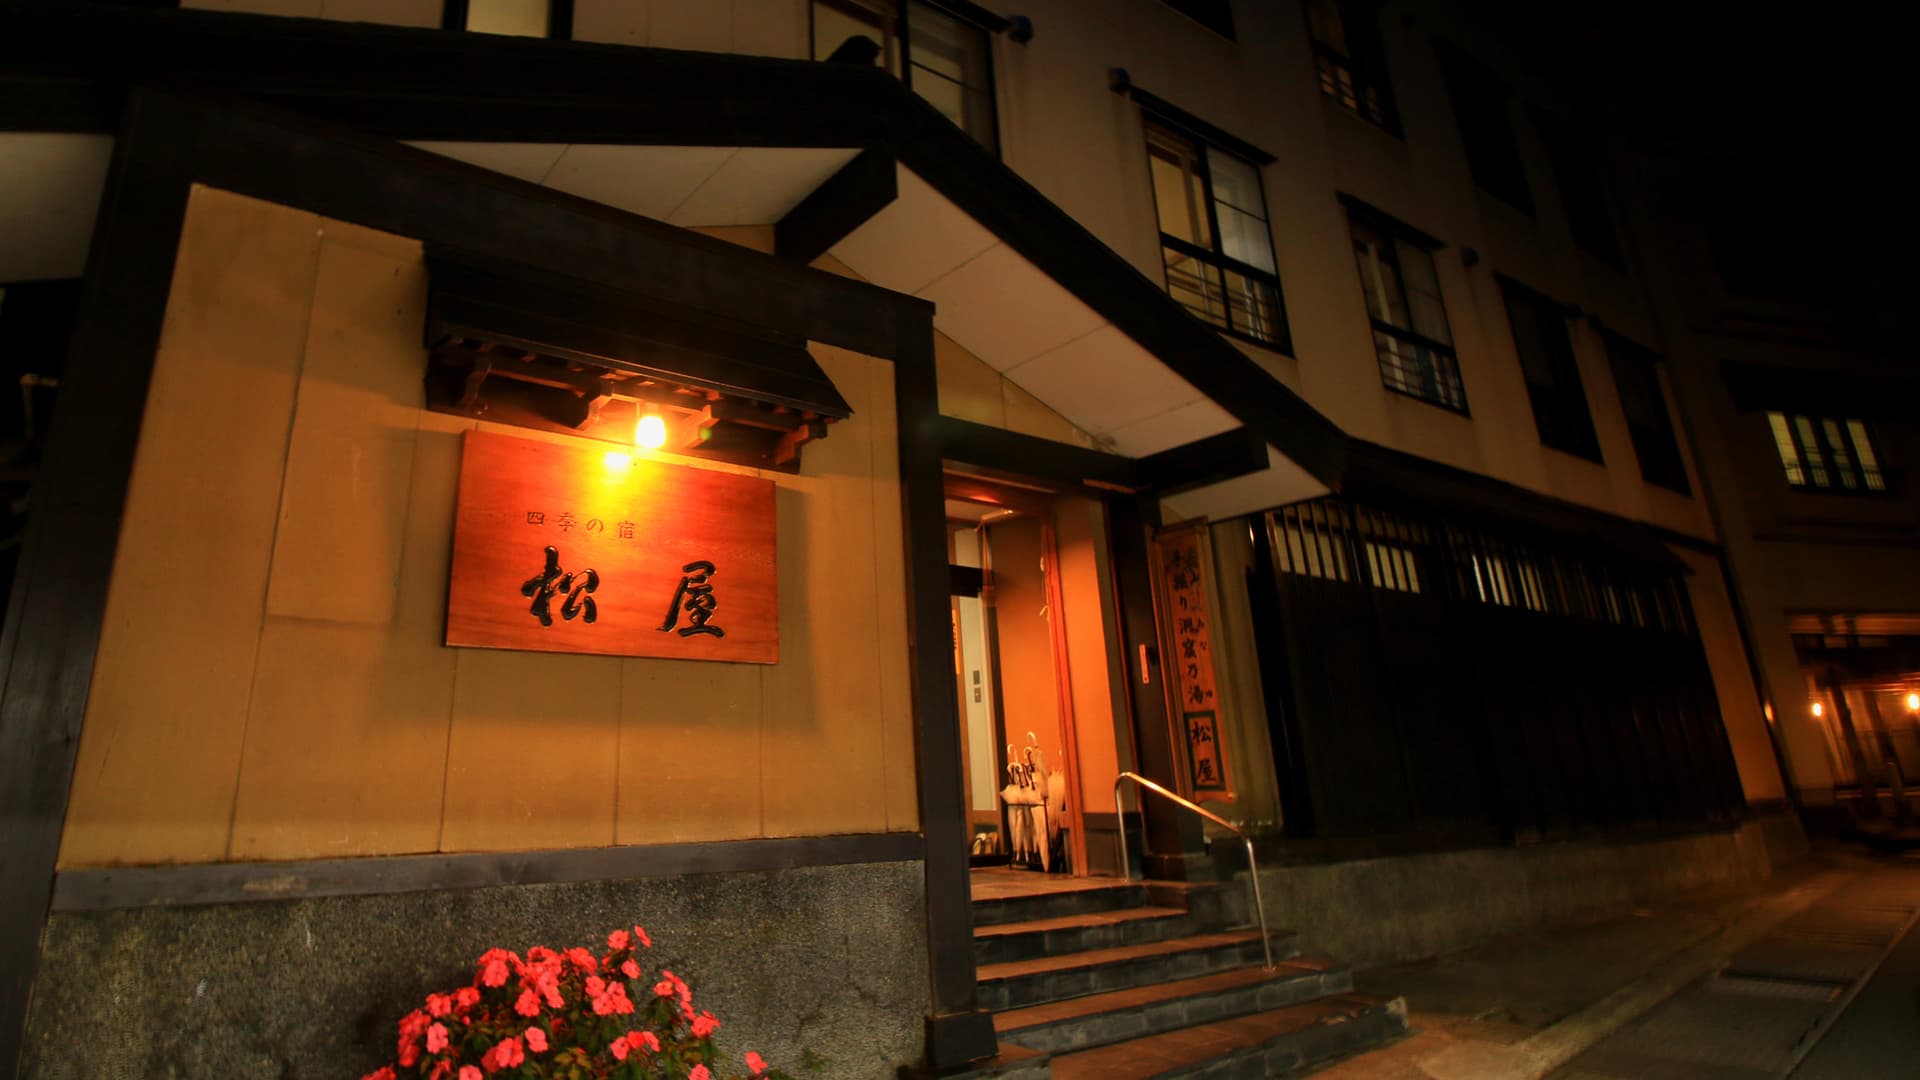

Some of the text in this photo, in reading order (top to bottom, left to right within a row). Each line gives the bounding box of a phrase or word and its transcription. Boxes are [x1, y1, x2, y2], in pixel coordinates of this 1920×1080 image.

[526, 510, 637, 540] 四季の宿
[520, 545, 726, 639] 松屋
[1191, 720, 1217, 783] 松屋
